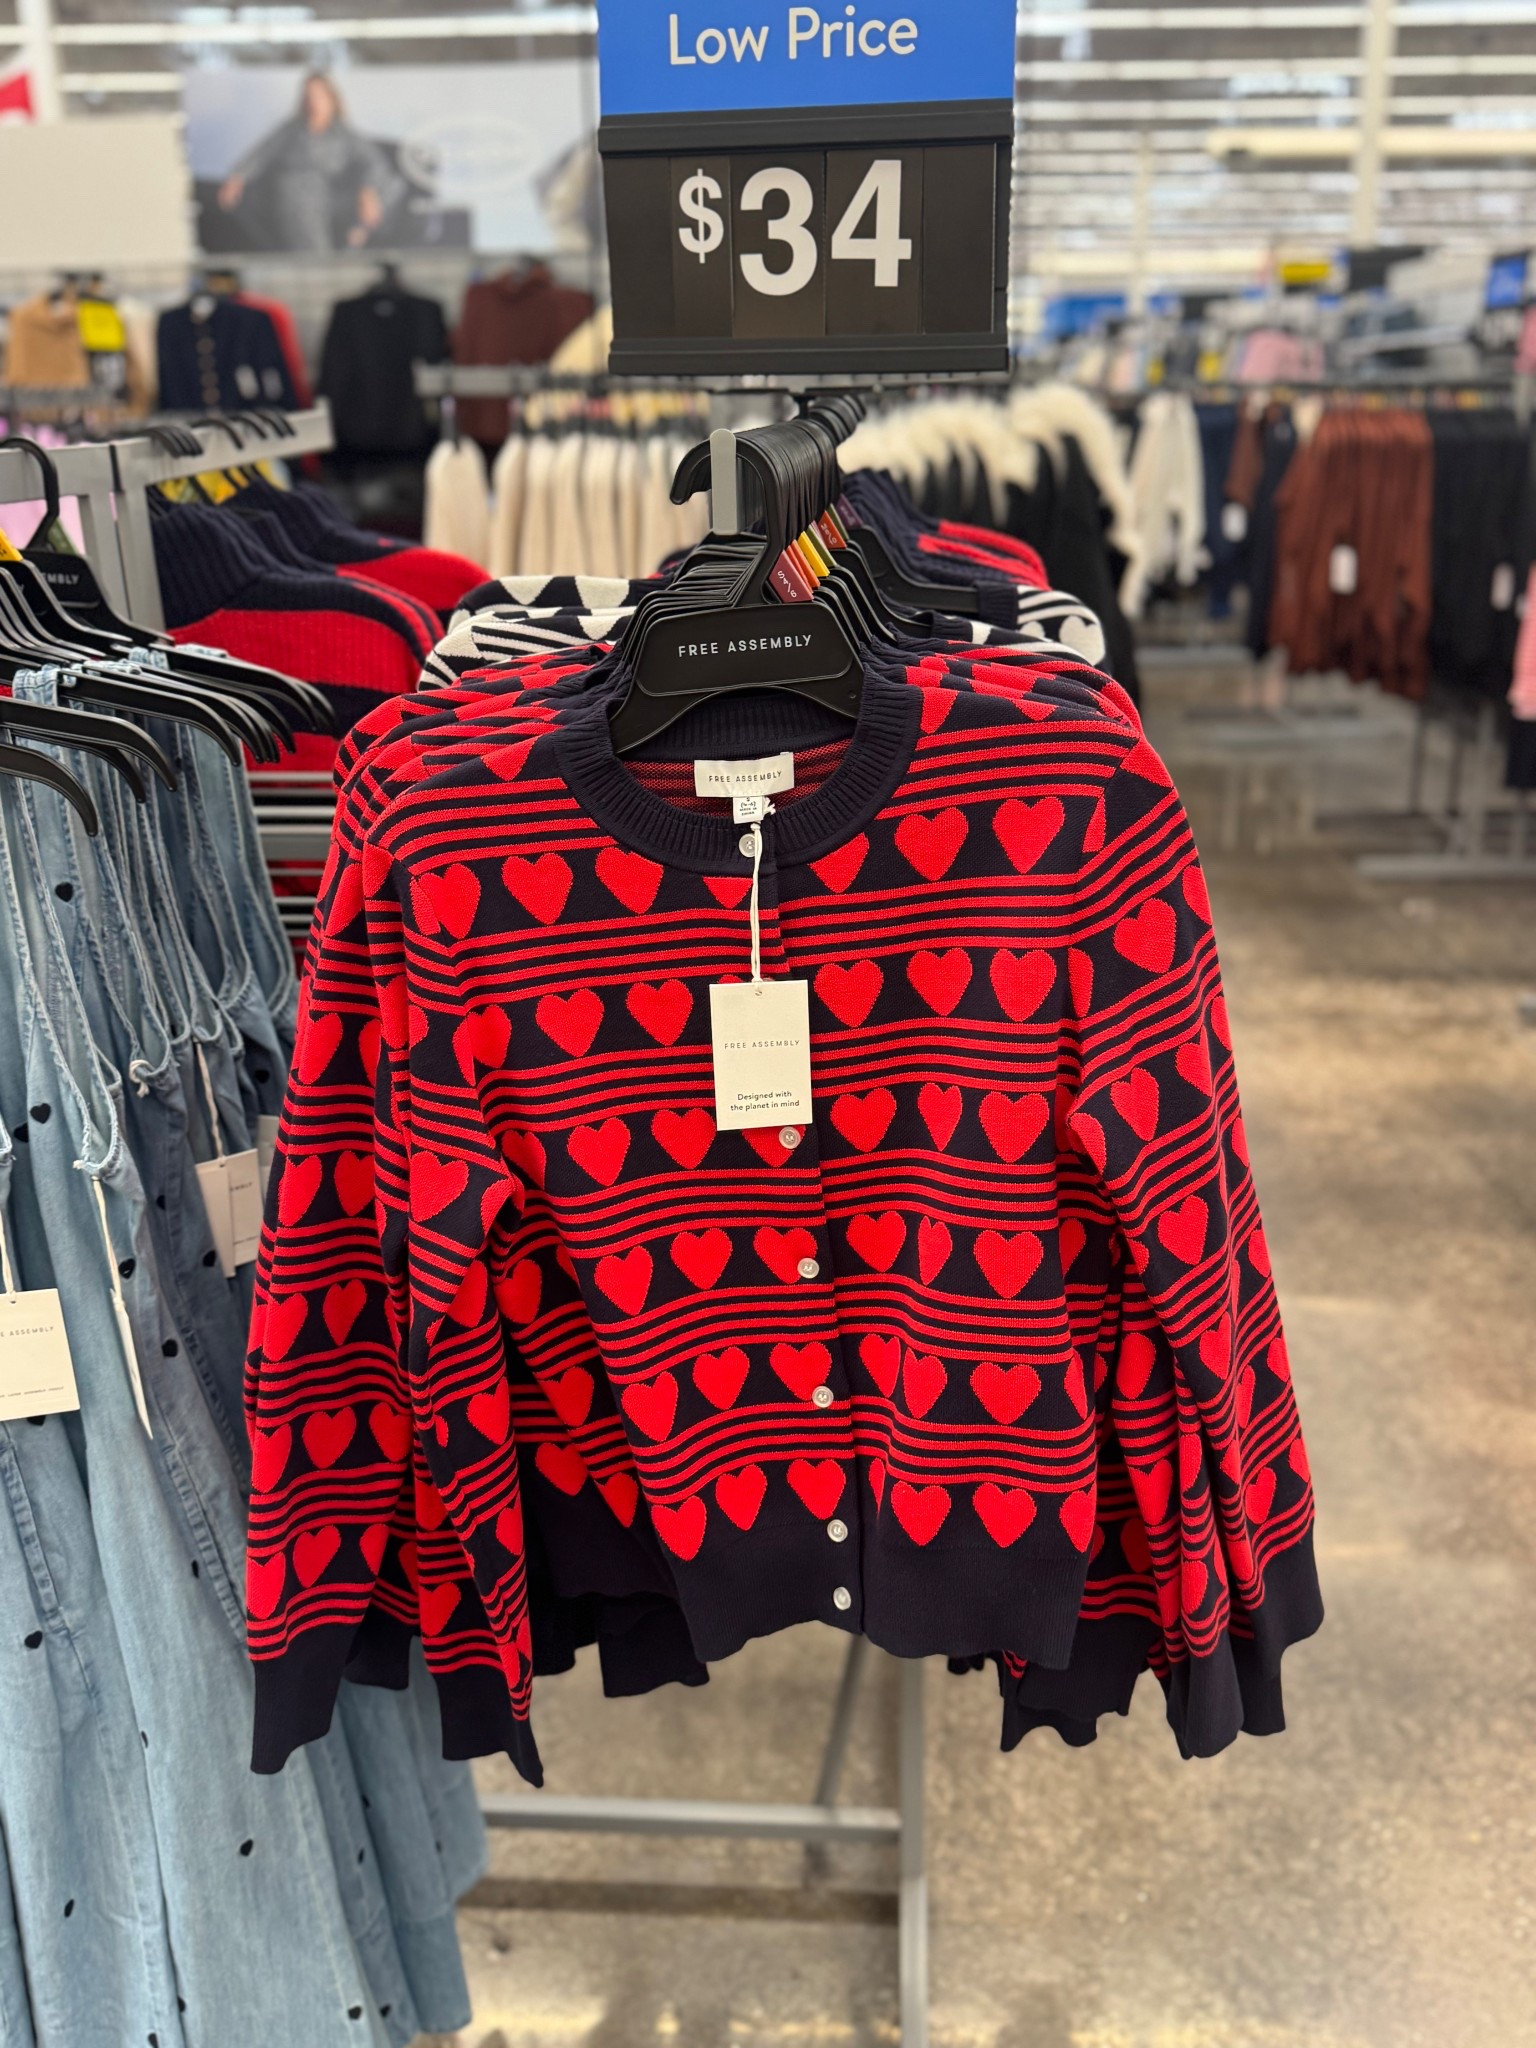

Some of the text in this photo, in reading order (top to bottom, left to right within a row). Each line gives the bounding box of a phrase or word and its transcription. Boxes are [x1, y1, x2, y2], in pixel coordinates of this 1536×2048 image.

[669, 4, 919, 66] Low Price
[678, 159, 913, 297] $34
[678, 634, 812, 658] FREE ASSEMBLY
[708, 770, 782, 783] FREE ASSEMBLY
[724, 1039, 800, 1050] FREE ASSEMBLY
[737, 1090, 792, 1101] Designed with
[745, 1103, 770, 1112] planet
[771, 1101, 779, 1109] in
[780, 1100, 800, 1108] mind
